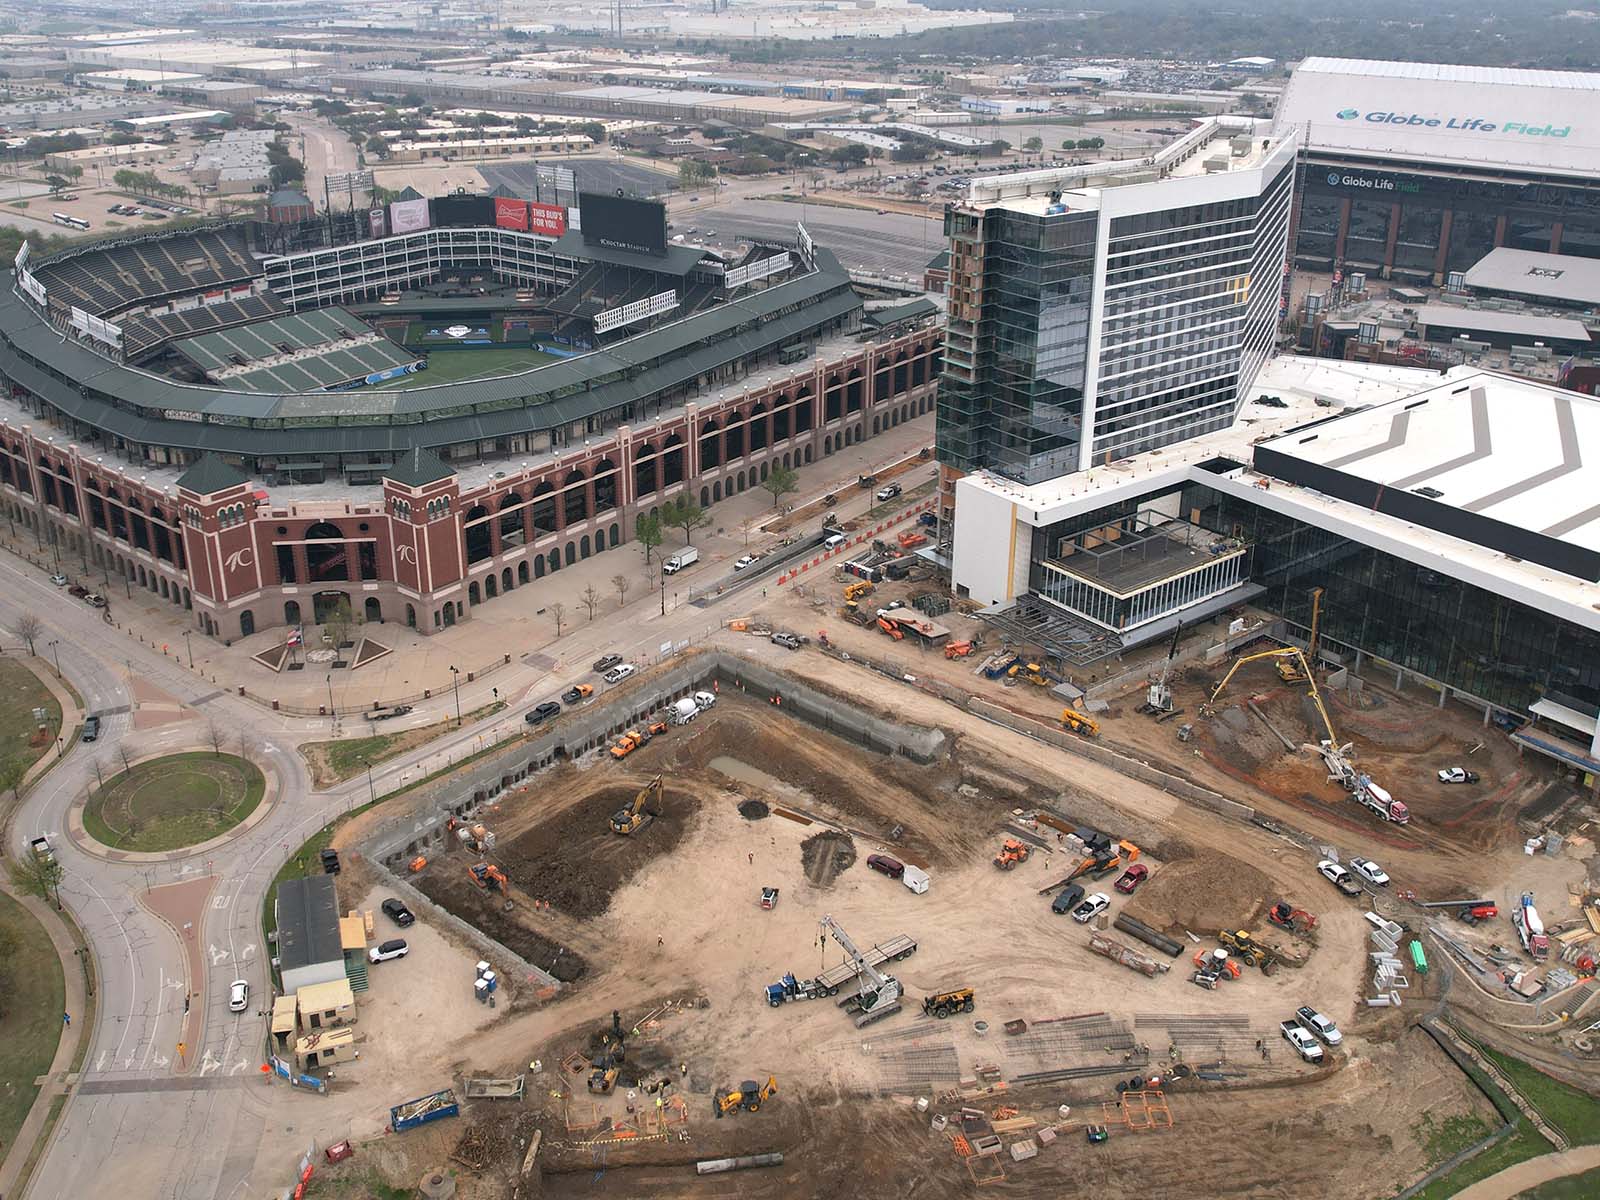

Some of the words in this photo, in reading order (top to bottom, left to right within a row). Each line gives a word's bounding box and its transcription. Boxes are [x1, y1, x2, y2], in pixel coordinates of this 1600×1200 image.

[1365, 111, 1440, 127] Globe
[1447, 118, 1496, 132] Life
[1502, 122, 1572, 138] Field
[1342, 175, 1373, 188] Globe
[1374, 178, 1394, 190] Life
[533, 208, 545, 218] THIS
[533, 217, 545, 227] FOR
